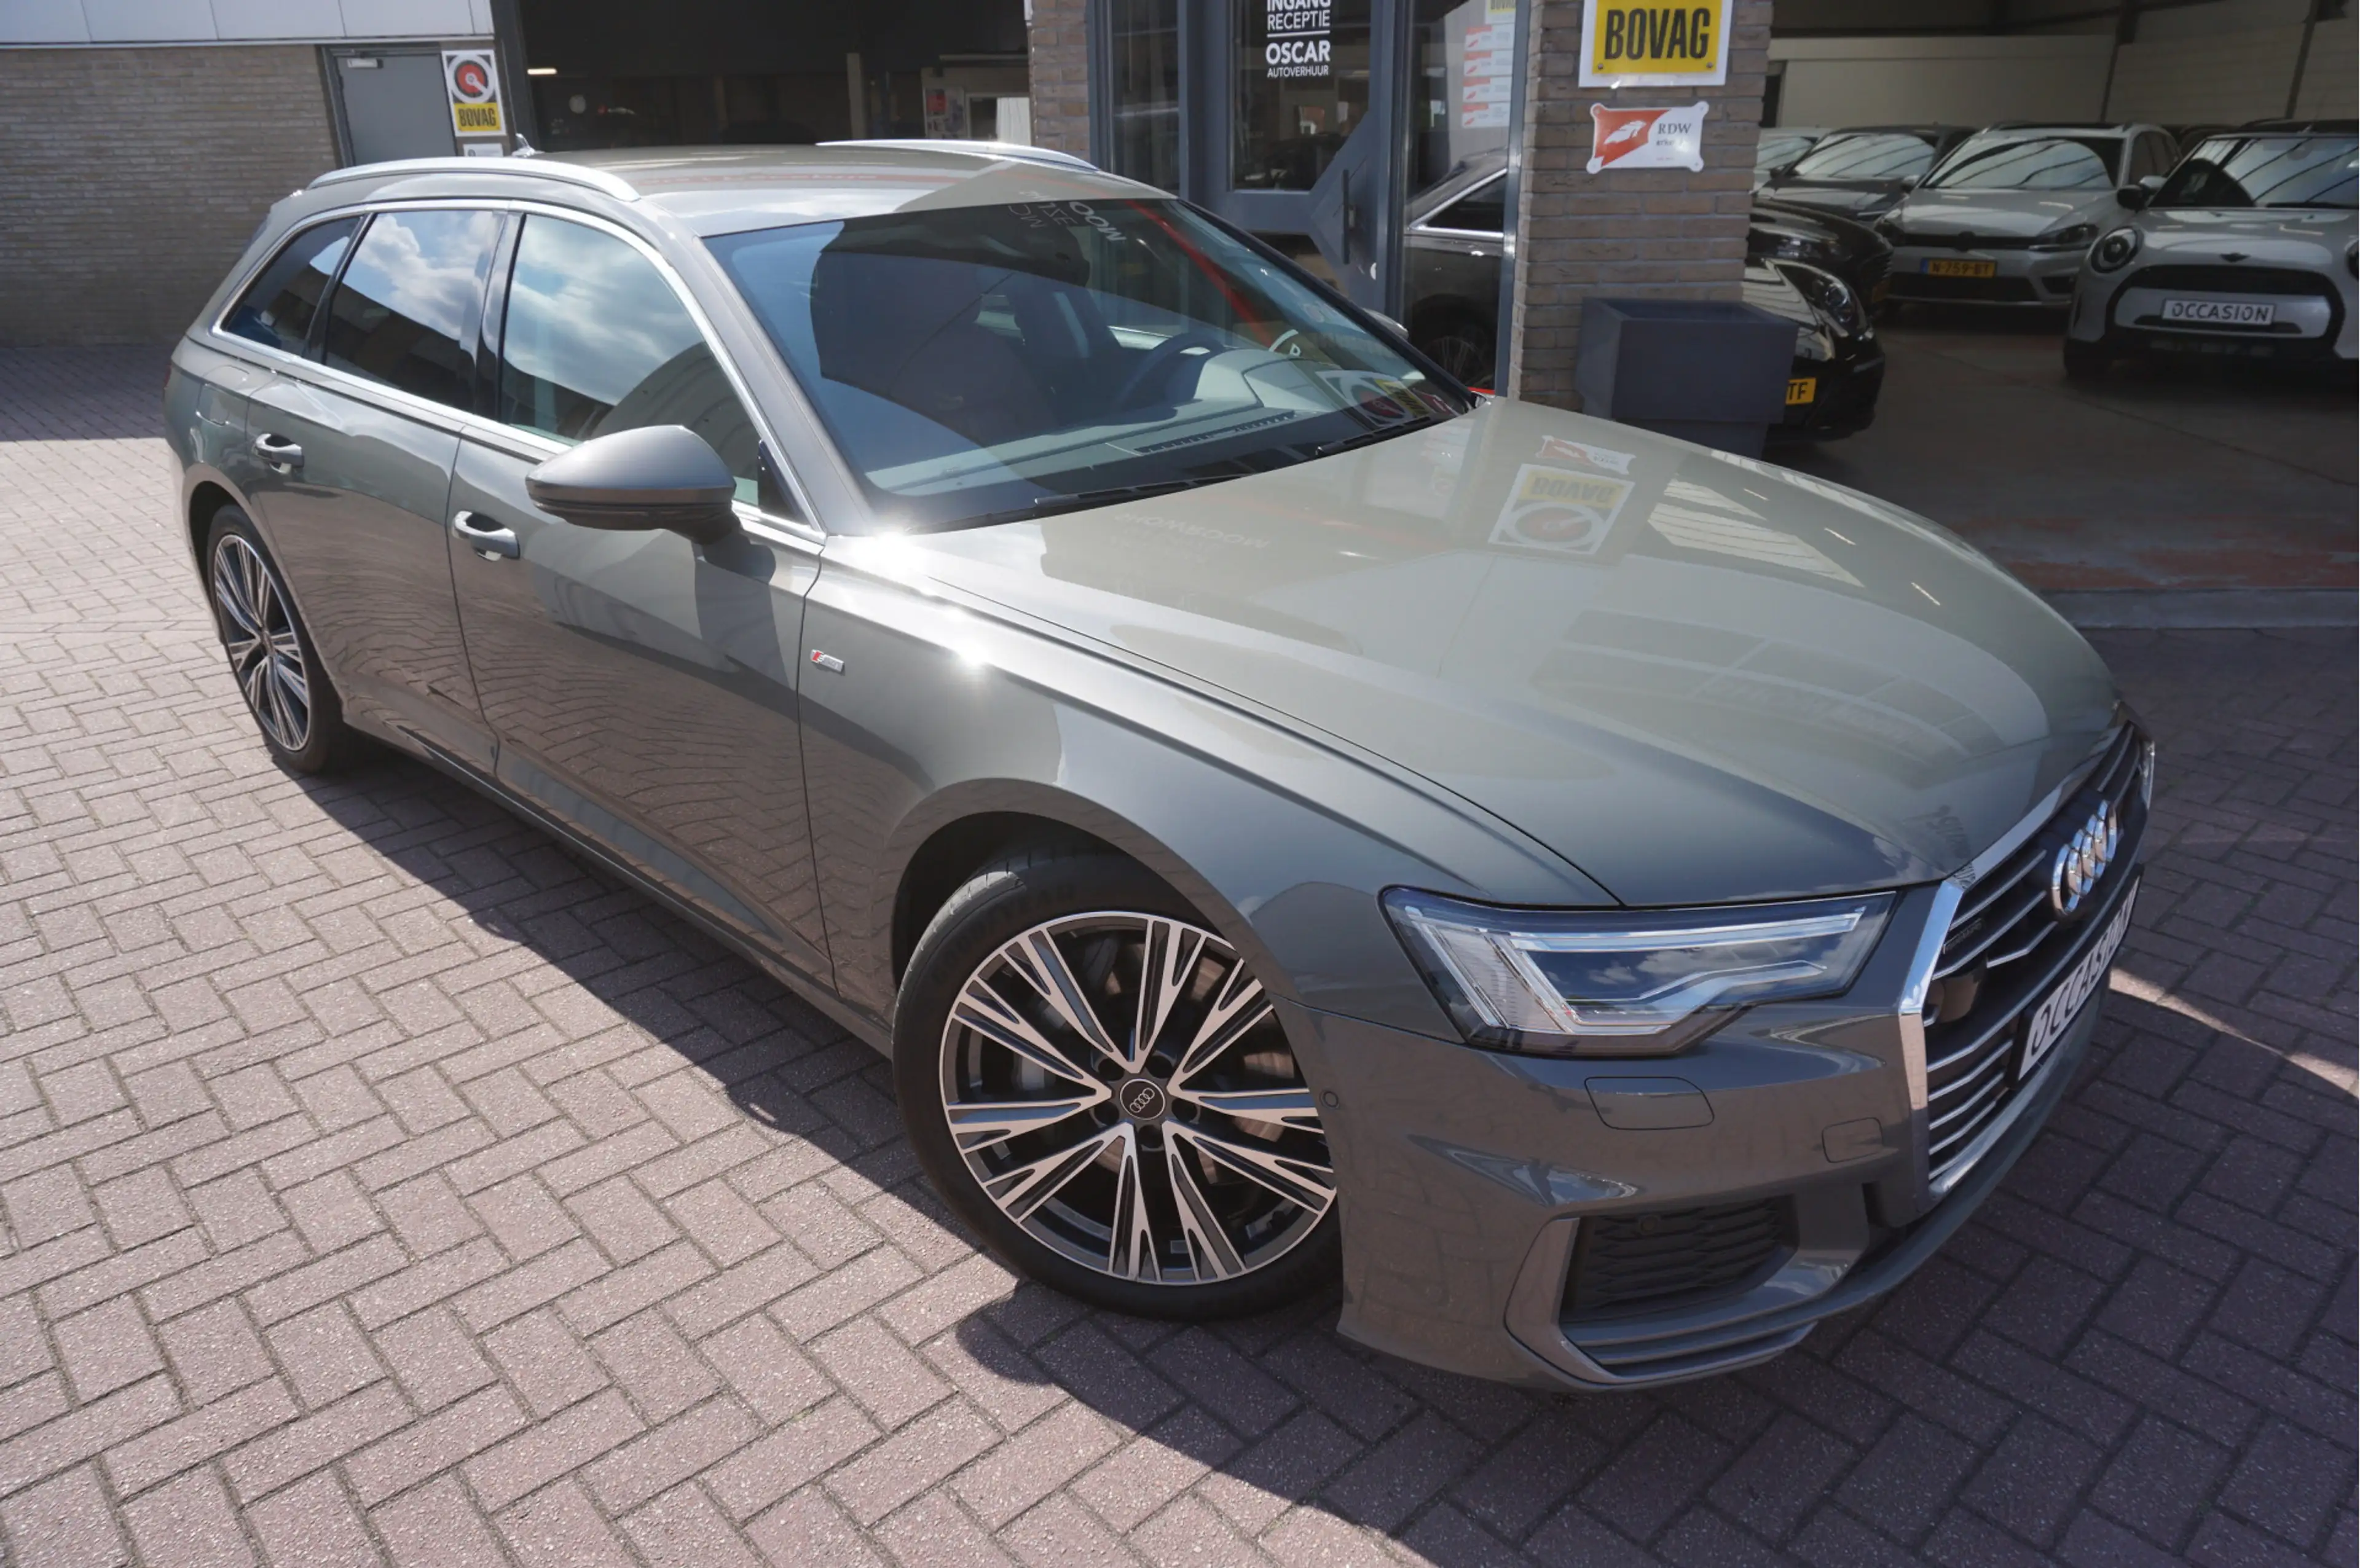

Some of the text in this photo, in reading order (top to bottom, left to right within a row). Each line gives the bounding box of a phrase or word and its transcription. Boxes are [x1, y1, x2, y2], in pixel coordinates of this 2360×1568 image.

[1267, 10, 1331, 31] RECEPTIE
[1605, 8, 1710, 60] BOVAG
[1266, 40, 1331, 65] OSCAR
[1267, 65, 1329, 77] AUTOVERHUUR
[458, 108, 496, 127] BOVAG
[1658, 123, 1692, 135] RDW
[2172, 303, 2269, 321] OCCASION
